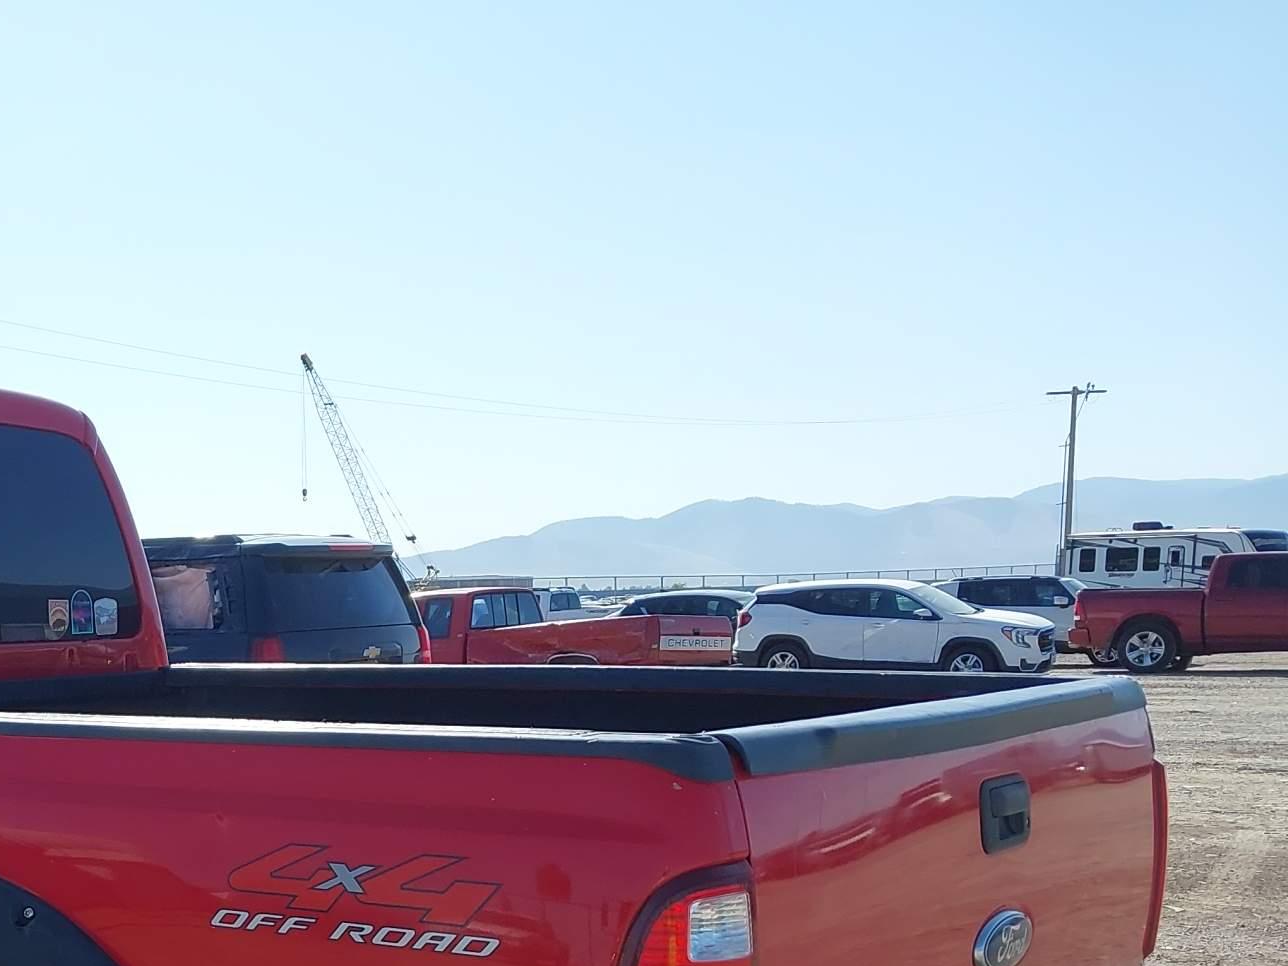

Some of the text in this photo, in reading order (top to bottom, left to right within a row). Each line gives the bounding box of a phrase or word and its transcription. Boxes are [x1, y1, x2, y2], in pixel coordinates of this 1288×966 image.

[667, 638, 725, 648] CHEVROLET
[211, 908, 502, 958] OFF ROAD
